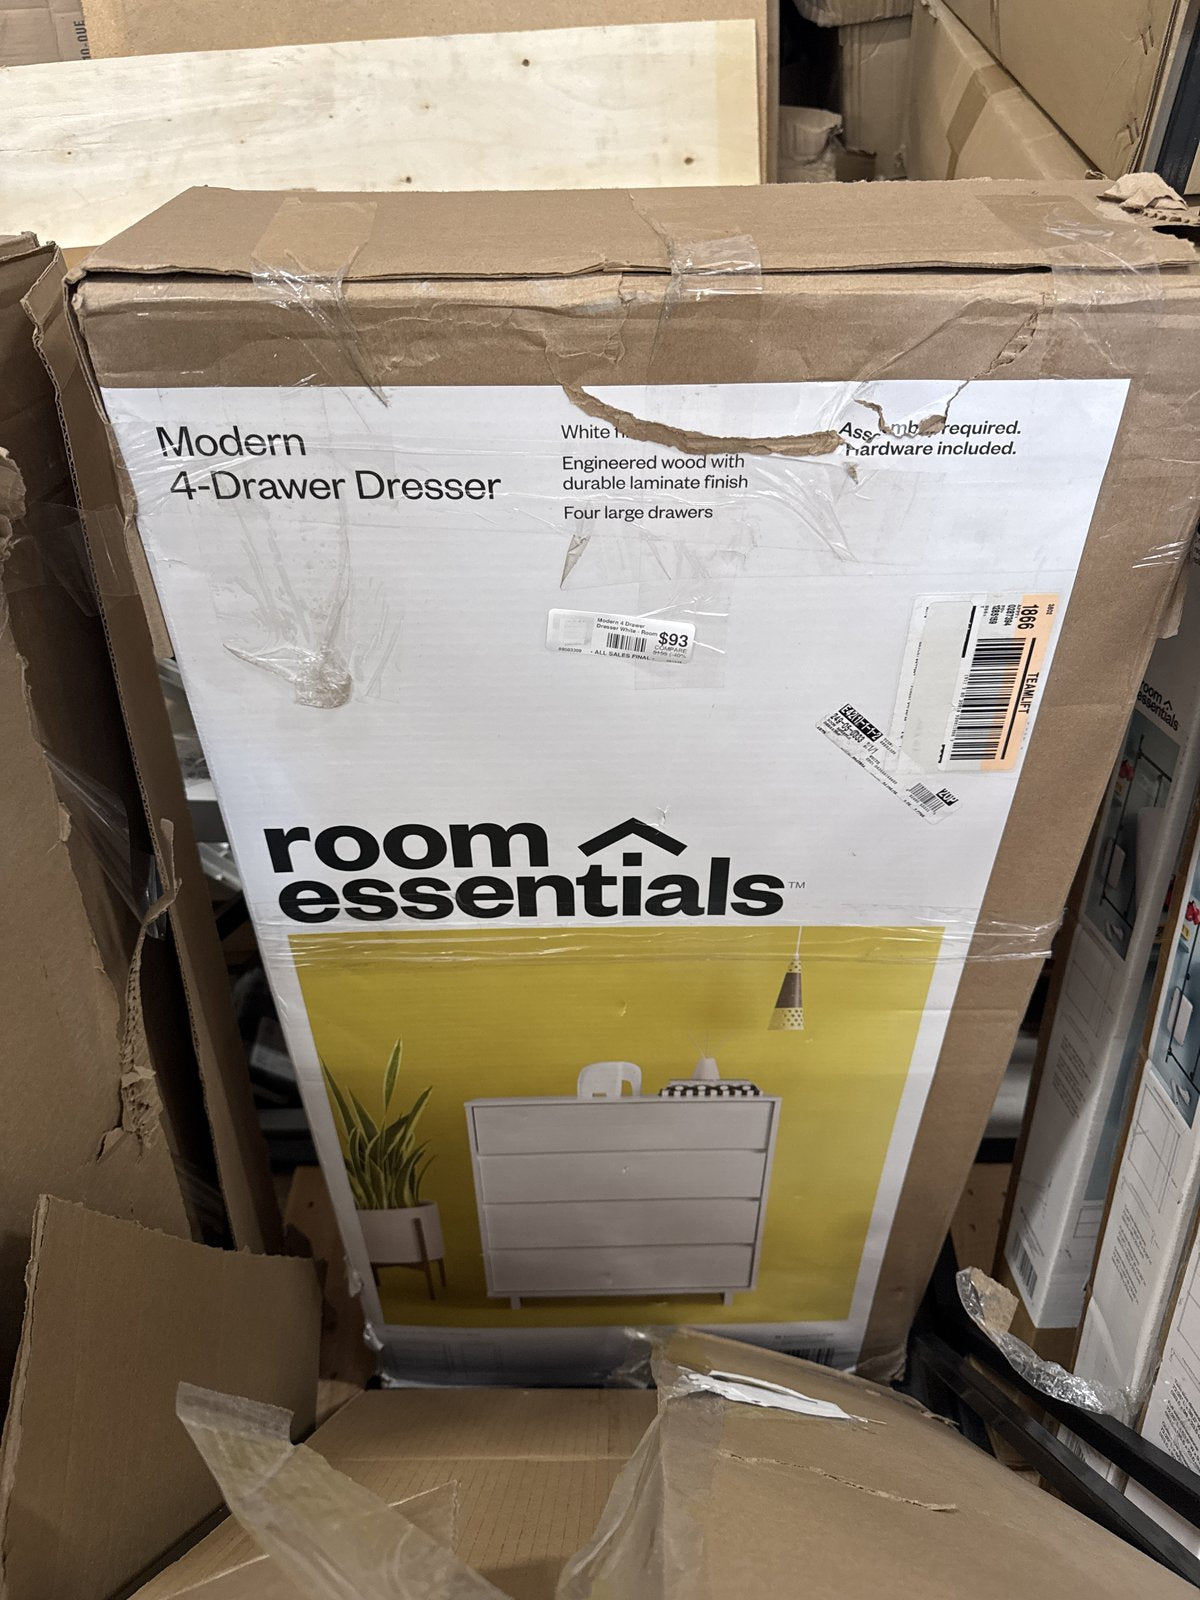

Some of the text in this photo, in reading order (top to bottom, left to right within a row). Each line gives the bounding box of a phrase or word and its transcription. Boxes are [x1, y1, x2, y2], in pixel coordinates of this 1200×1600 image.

[561, 424, 611, 439] White
[942, 420, 1021, 437] required.
[155, 425, 307, 457] Modern
[936, 440, 1017, 455] included.
[562, 454, 745, 473] Engineered wood with
[170, 470, 502, 500] 4-Drawer Dresser
[563, 474, 749, 490] durable laminate finish
[564, 505, 713, 522] Four large drawers
[597, 617, 620, 626] Modern
[625, 620, 646, 629] Drawer
[1017, 604, 1040, 630] 1866
[596, 622, 619, 632] Dresser
[620, 625, 637, 634] White
[641, 629, 658, 637] Room
[658, 631, 689, 648] $93
[609, 651, 631, 659] SALES
[631, 653, 651, 661] FINAL
[654, 644, 688, 654] COMPARE
[1018, 672, 1040, 714] TEAMLIFT
[1137, 680, 1179, 731] room essentials
[263, 821, 549, 873] room
[277, 851, 786, 923] essentials
